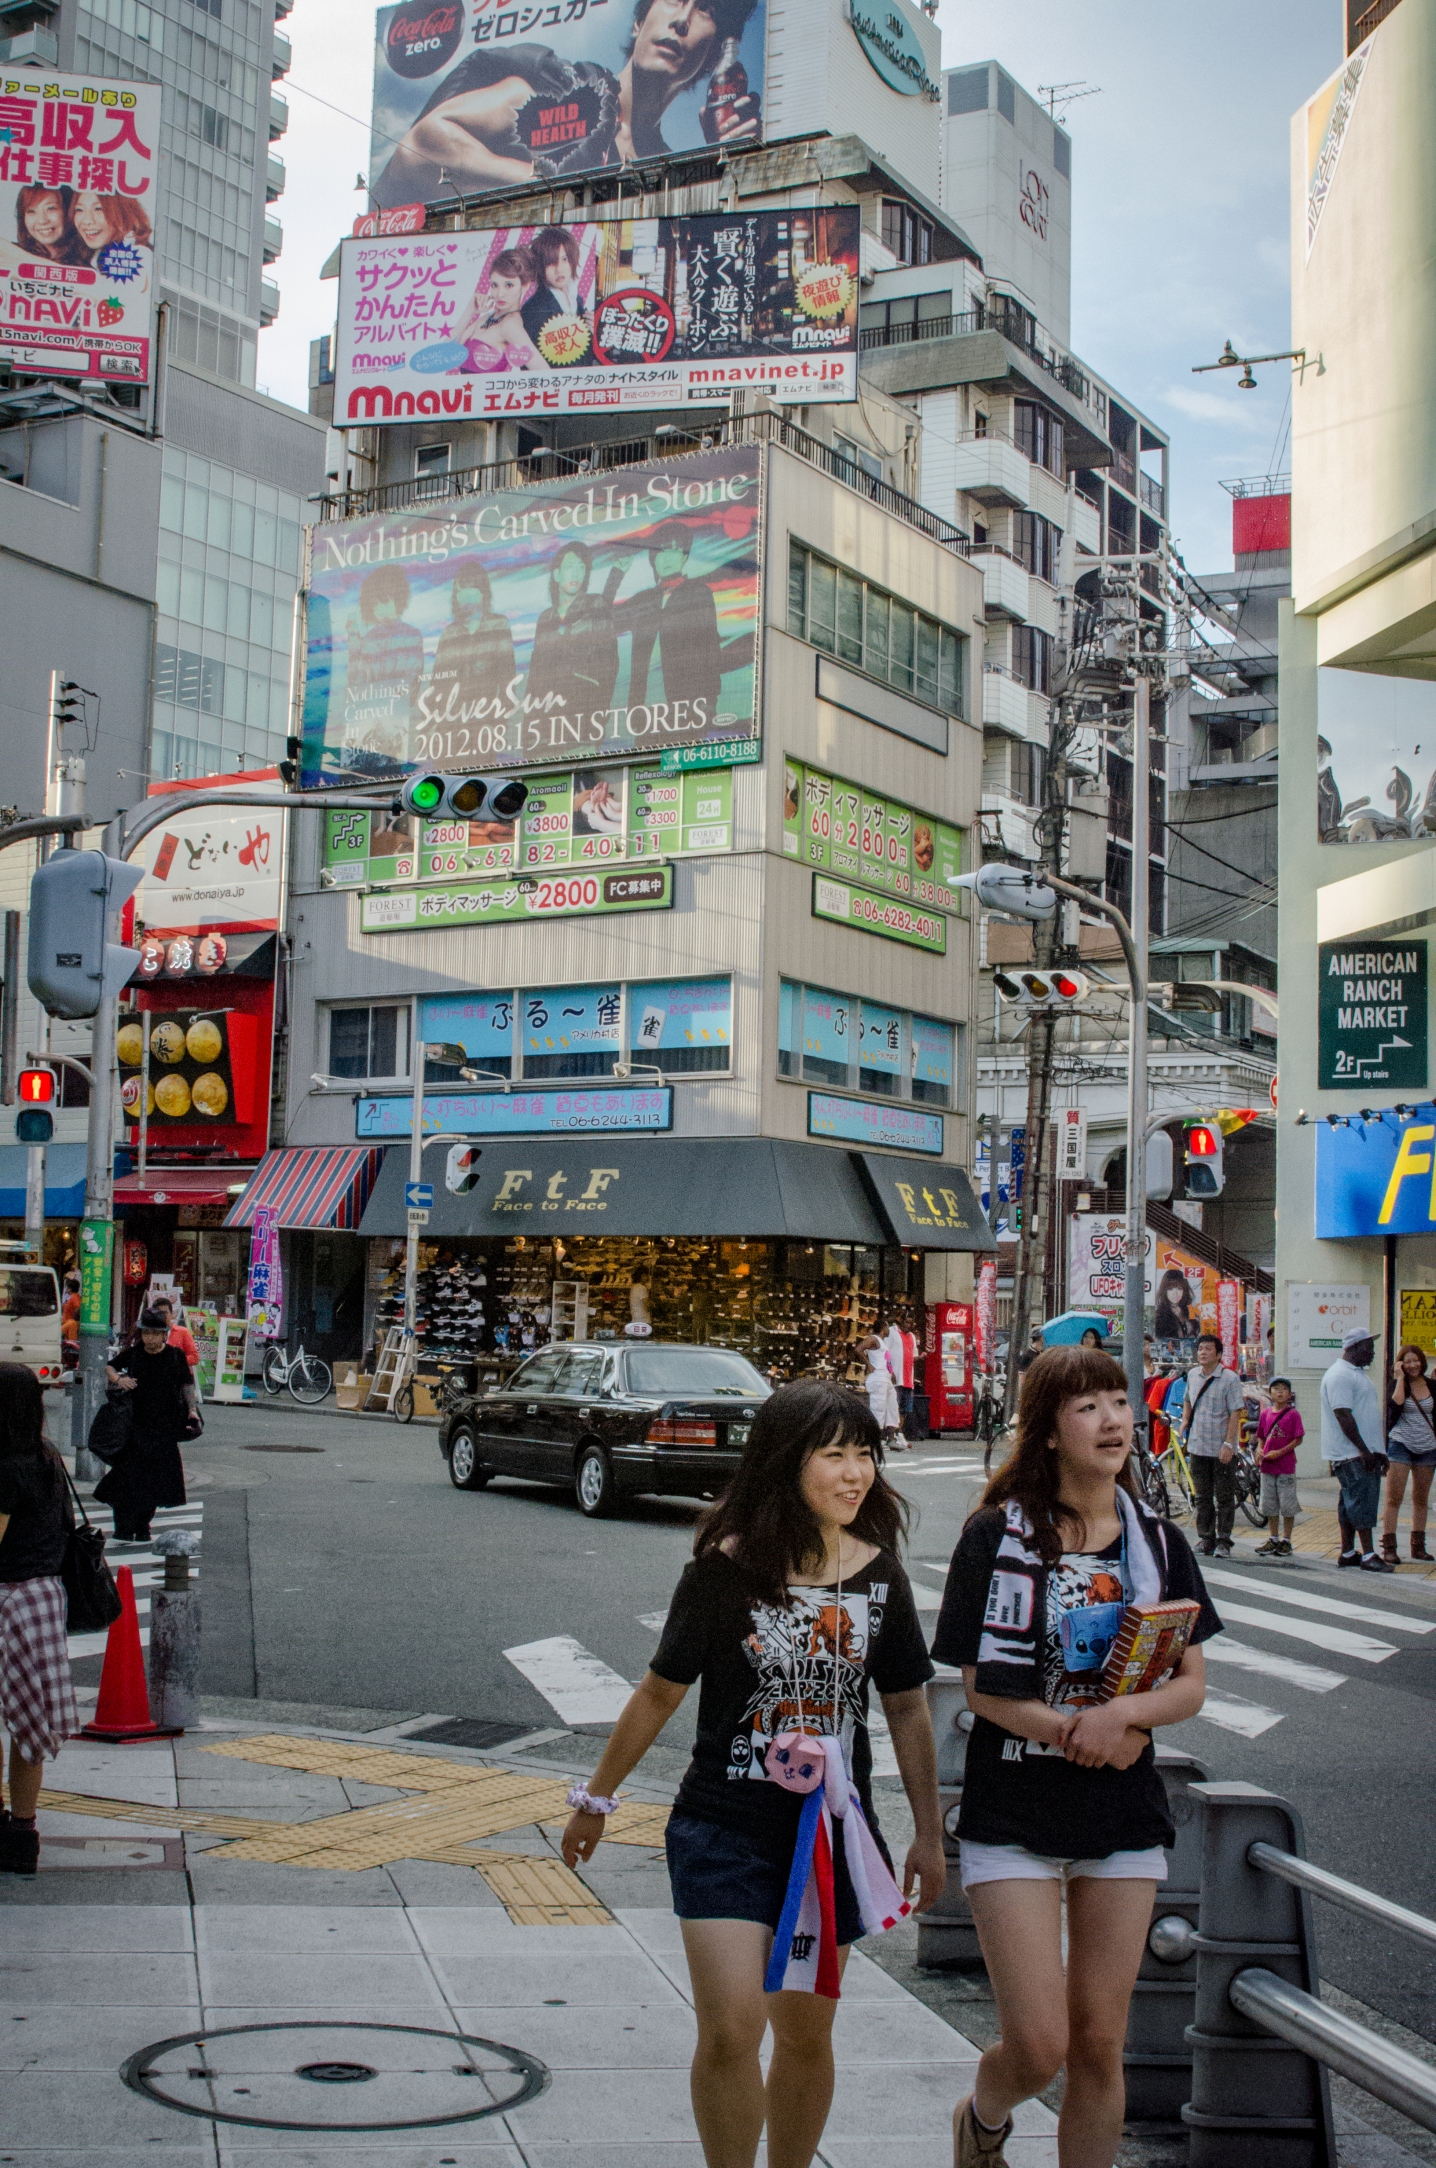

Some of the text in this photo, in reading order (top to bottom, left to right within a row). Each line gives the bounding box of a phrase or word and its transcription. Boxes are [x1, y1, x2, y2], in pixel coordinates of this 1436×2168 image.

[389, 6, 456, 46] Coca-Cola
[471, 0, 609, 43] ゼロシュガー
[405, 36, 441, 56] zero
[538, 103, 579, 127] WILD
[0, 96, 151, 160] 高収入
[531, 119, 587, 147] HEALTH
[357, 245, 446, 261] カワイく 楽しく
[33, 266, 78, 282] 関西版
[355, 258, 457, 292] サクッと
[10, 281, 74, 298] いちごナビ
[801, 275, 843, 297] 夜遊び
[354, 291, 455, 321] かんたん
[689, 244, 709, 352] 大人のクーポン
[811, 292, 843, 309] 情報
[601, 306, 670, 333] ぼったくり
[353, 328, 437, 344] アルバイト
[545, 323, 584, 346] 高収入
[553, 337, 582, 356] 求人
[106, 357, 134, 370] 検索
[688, 360, 845, 383] mnavinet.jp
[483, 388, 561, 412] エムナビ
[570, 390, 620, 406] 毎月発刊
[322, 471, 749, 572] Nothing's Carved In Stone
[417, 669, 458, 683] NEW ALBUM
[345, 679, 410, 704] Nothing's
[344, 698, 394, 721] Carved
[413, 697, 709, 763] 2012.08.15 IN STORES
[683, 740, 758, 763] 06-6110-8188
[530, 783, 567, 796] Aromaoil
[696, 784, 723, 795] House
[806, 774, 910, 836] ボディマッサージ
[183, 824, 271, 874] どないや
[348, 835, 365, 849] 3F
[810, 842, 825, 862] 3F
[171, 886, 245, 903] www.donaiya.jp
[420, 890, 518, 915] ボディマッサージ
[609, 877, 663, 897] FC募集中
[819, 883, 848, 903] FOREST
[368, 898, 412, 913] FOREST
[863, 898, 942, 944] 06-6282-4011
[1328, 951, 1418, 977] AMERICAN
[1343, 979, 1403, 1003] RANCH
[641, 1014, 660, 1040] 雀
[1337, 1006, 1409, 1030] MARKET
[570, 1027, 621, 1042] アメリカ村店
[1335, 1050, 1355, 1073] 2F
[1363, 1069, 1390, 1080] Up stairs
[550, 1119, 568, 1128] TEL
[1066, 1110, 1080, 1125] 質
[1066, 1128, 1078, 1169] 三国屋
[491, 1197, 608, 1212] Face to Face
[908, 1212, 970, 1230] Face to Face
[251, 1208, 271, 1299] フリー麻雀
[1186, 1268, 1202, 1278] 2F
[868, 1582, 889, 1604] XIII
